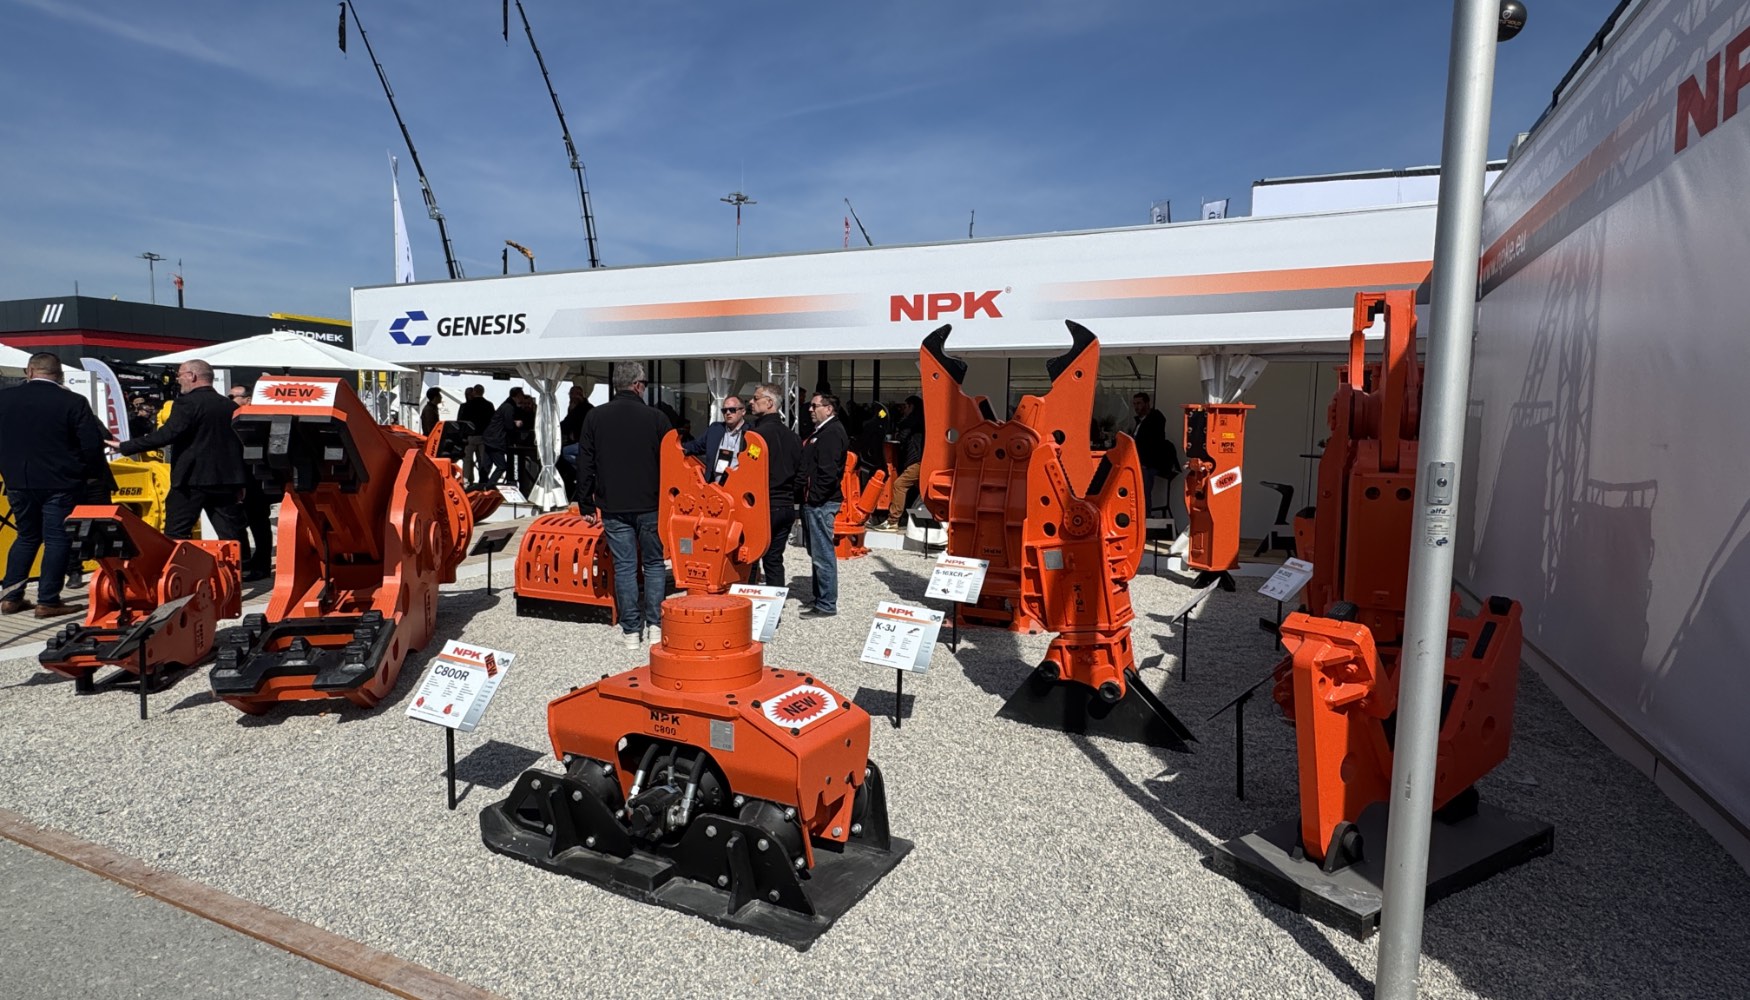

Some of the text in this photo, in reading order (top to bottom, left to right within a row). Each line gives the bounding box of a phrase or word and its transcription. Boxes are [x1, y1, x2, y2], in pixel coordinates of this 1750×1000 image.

[890, 290, 1003, 321] NPK
[437, 313, 526, 337] GENESIS
[274, 388, 314, 397] NEW
[1219, 475, 1234, 485] NEW
[1073, 584, 1085, 612] K-3J
[887, 606, 915, 617] NPK
[875, 622, 896, 632] K-3J
[452, 646, 483, 660] NPK
[434, 664, 470, 681] C800R
[484, 653, 497, 677] NEW
[782, 695, 818, 717] NEW
[650, 710, 680, 726] NPK
[654, 724, 677, 736] C800
